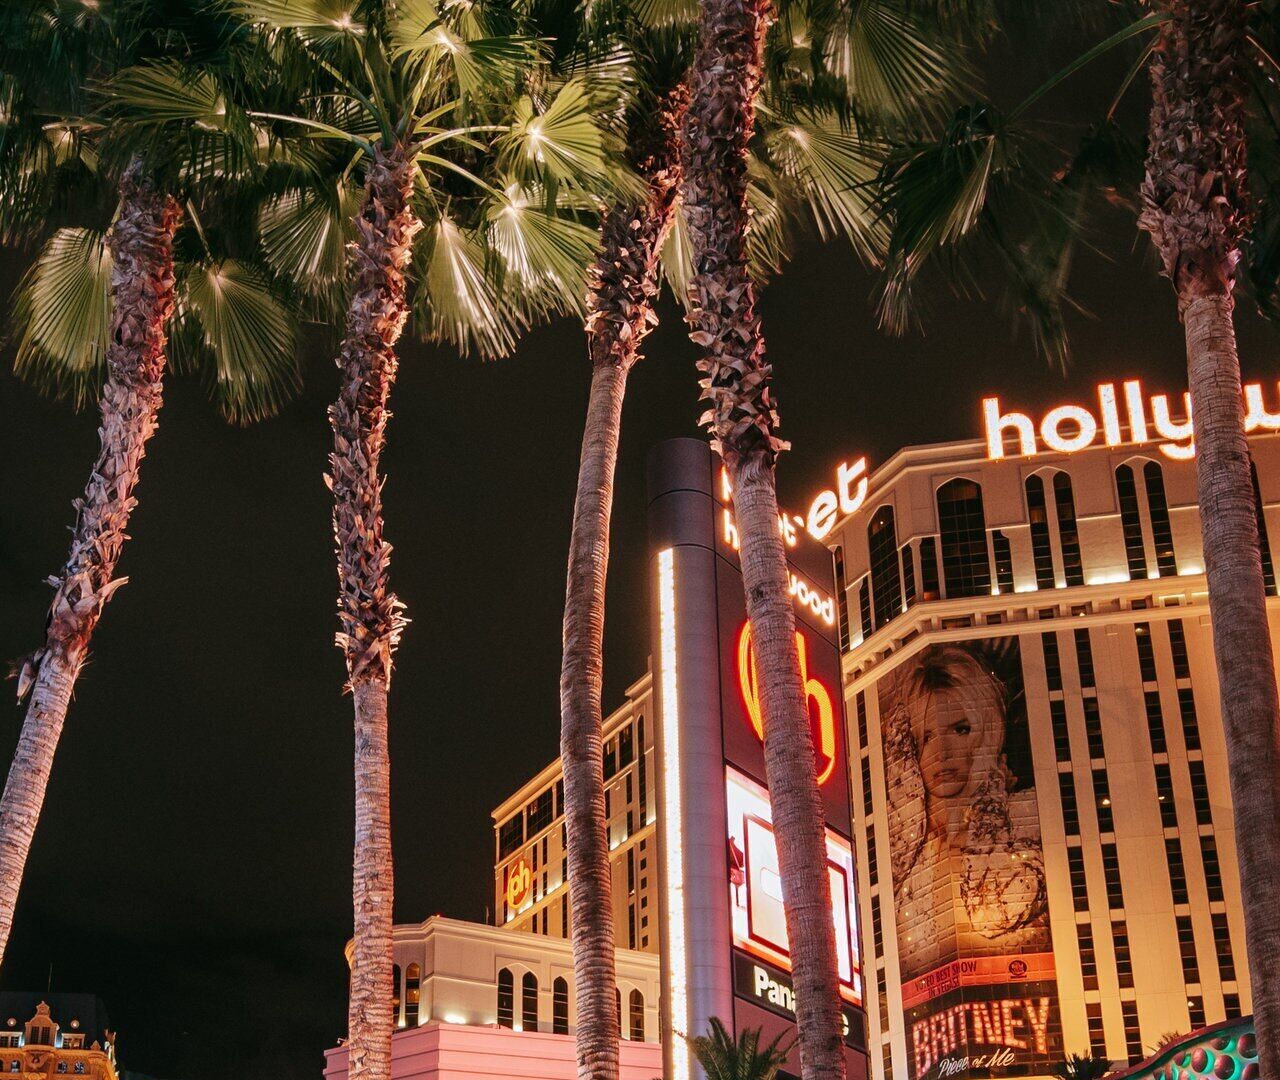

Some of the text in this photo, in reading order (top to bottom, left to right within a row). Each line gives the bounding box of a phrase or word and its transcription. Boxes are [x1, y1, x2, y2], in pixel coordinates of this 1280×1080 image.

[935, 966, 951, 983] BEST
[952, 960, 977, 975] SHOW
[938, 1047, 1016, 1080] Piece of Me
